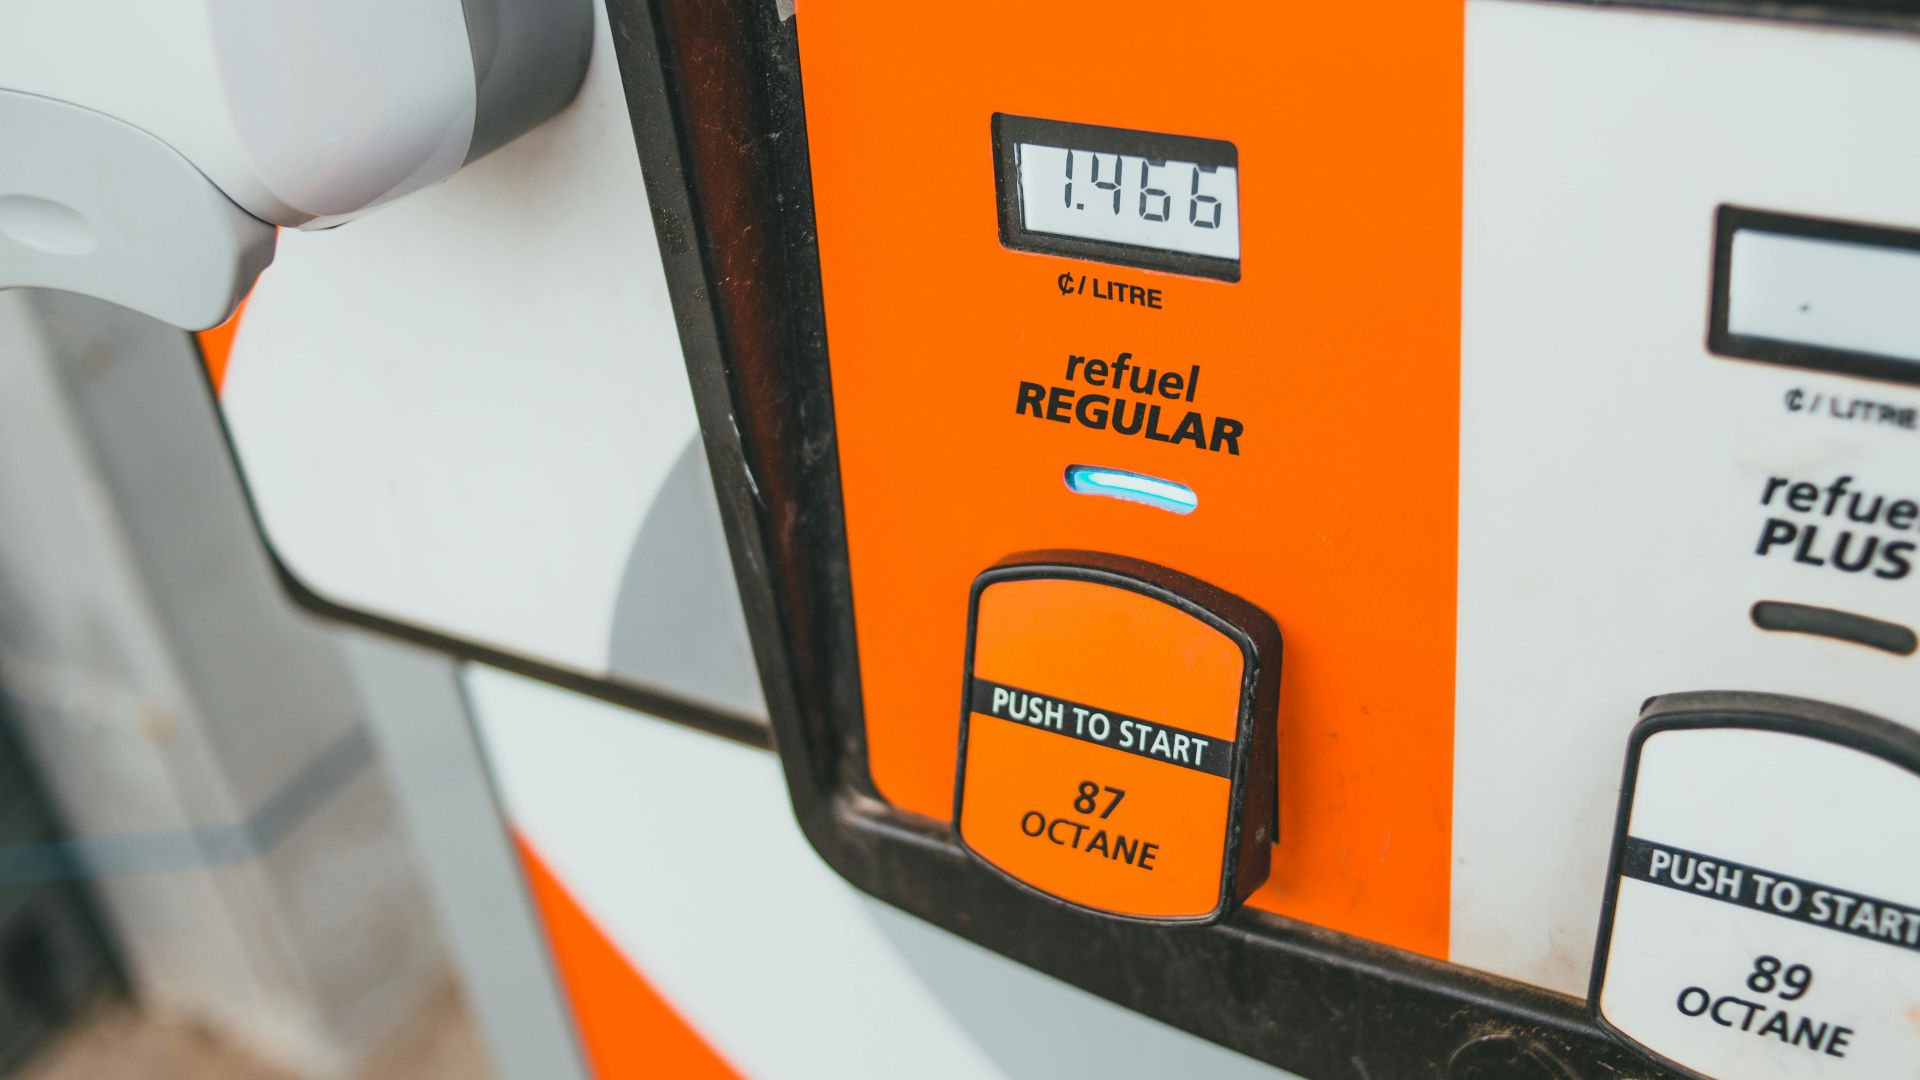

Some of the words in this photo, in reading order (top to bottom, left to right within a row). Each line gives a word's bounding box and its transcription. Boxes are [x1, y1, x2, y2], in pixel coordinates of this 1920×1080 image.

[1064, 149, 1222, 229] 1.466
[1092, 278, 1163, 310] LITRE
[1065, 352, 1200, 402] refuel
[1015, 381, 1244, 456] REGULAR
[1829, 396, 1919, 430] LITRE
[1761, 475, 1920, 533] refue
[1755, 517, 1917, 580] PLUS
[992, 687, 1064, 730] PUSH
[1072, 706, 1110, 741] TO
[1119, 720, 1209, 767] START
[1073, 780, 1126, 820] 87
[1021, 811, 1160, 871] OCTANE
[1649, 848, 1744, 900] PUSH
[1752, 873, 1801, 914] TO
[1809, 890, 1920, 945] START
[1746, 954, 1813, 1001] 89
[1676, 986, 1855, 1059] OCTANE
